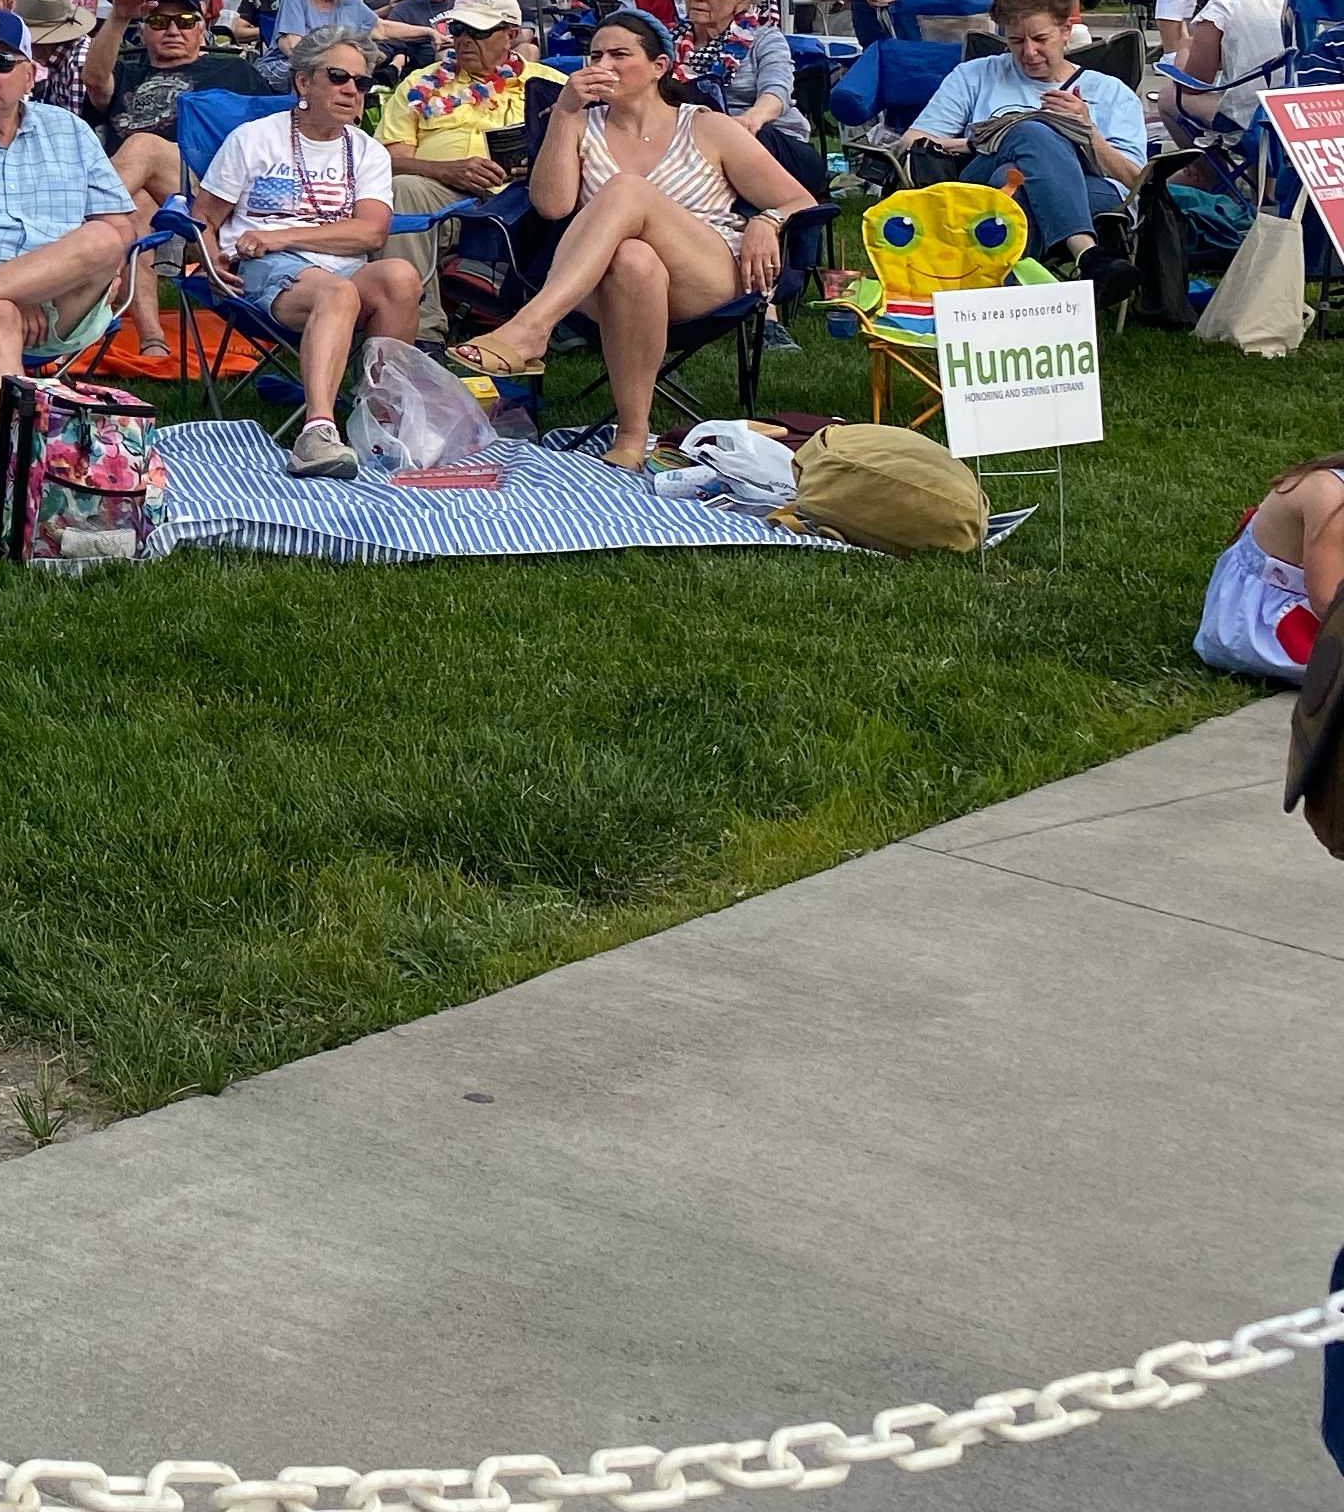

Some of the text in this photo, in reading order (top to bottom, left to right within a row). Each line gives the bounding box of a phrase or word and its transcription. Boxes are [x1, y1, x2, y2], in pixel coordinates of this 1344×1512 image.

[954, 310, 977, 323] This
[982, 309, 1005, 321] area
[1009, 302, 1062, 320] sponsored
[945, 341, 1095, 388] Humana
[964, 381, 1085, 403] HONORING AND SERVING VETERANS
